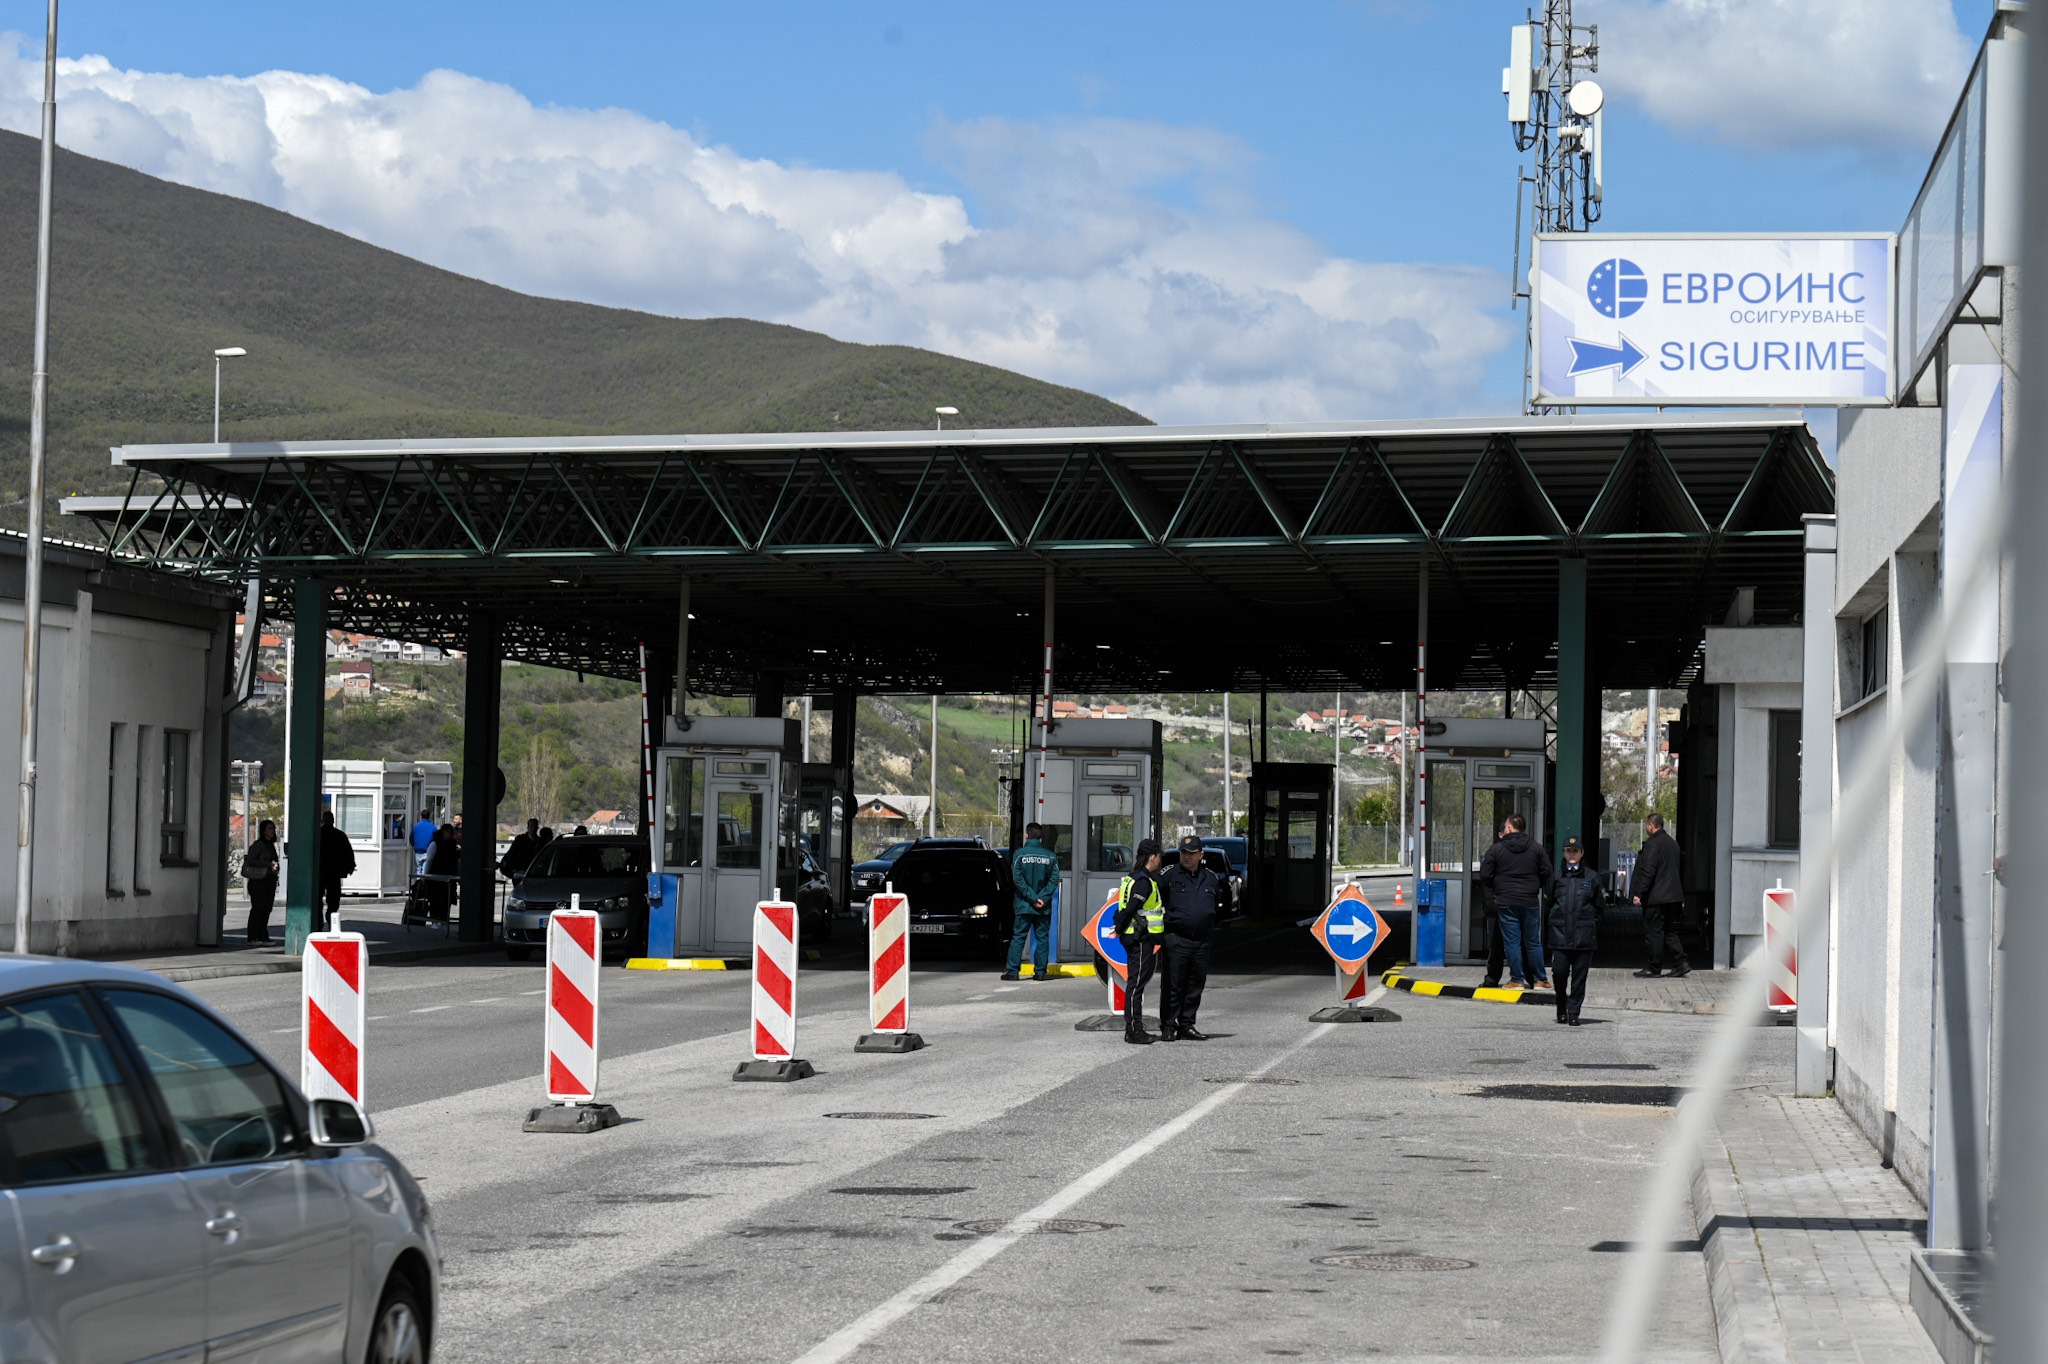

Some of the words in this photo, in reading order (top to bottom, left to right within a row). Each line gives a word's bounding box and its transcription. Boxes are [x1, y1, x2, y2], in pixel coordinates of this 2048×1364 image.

[1662, 272, 1866, 304] ЕВРОИНС
[1730, 310, 1865, 324] ОСИГУРУВАЊЕ
[1659, 341, 1866, 371] SIGURIME
